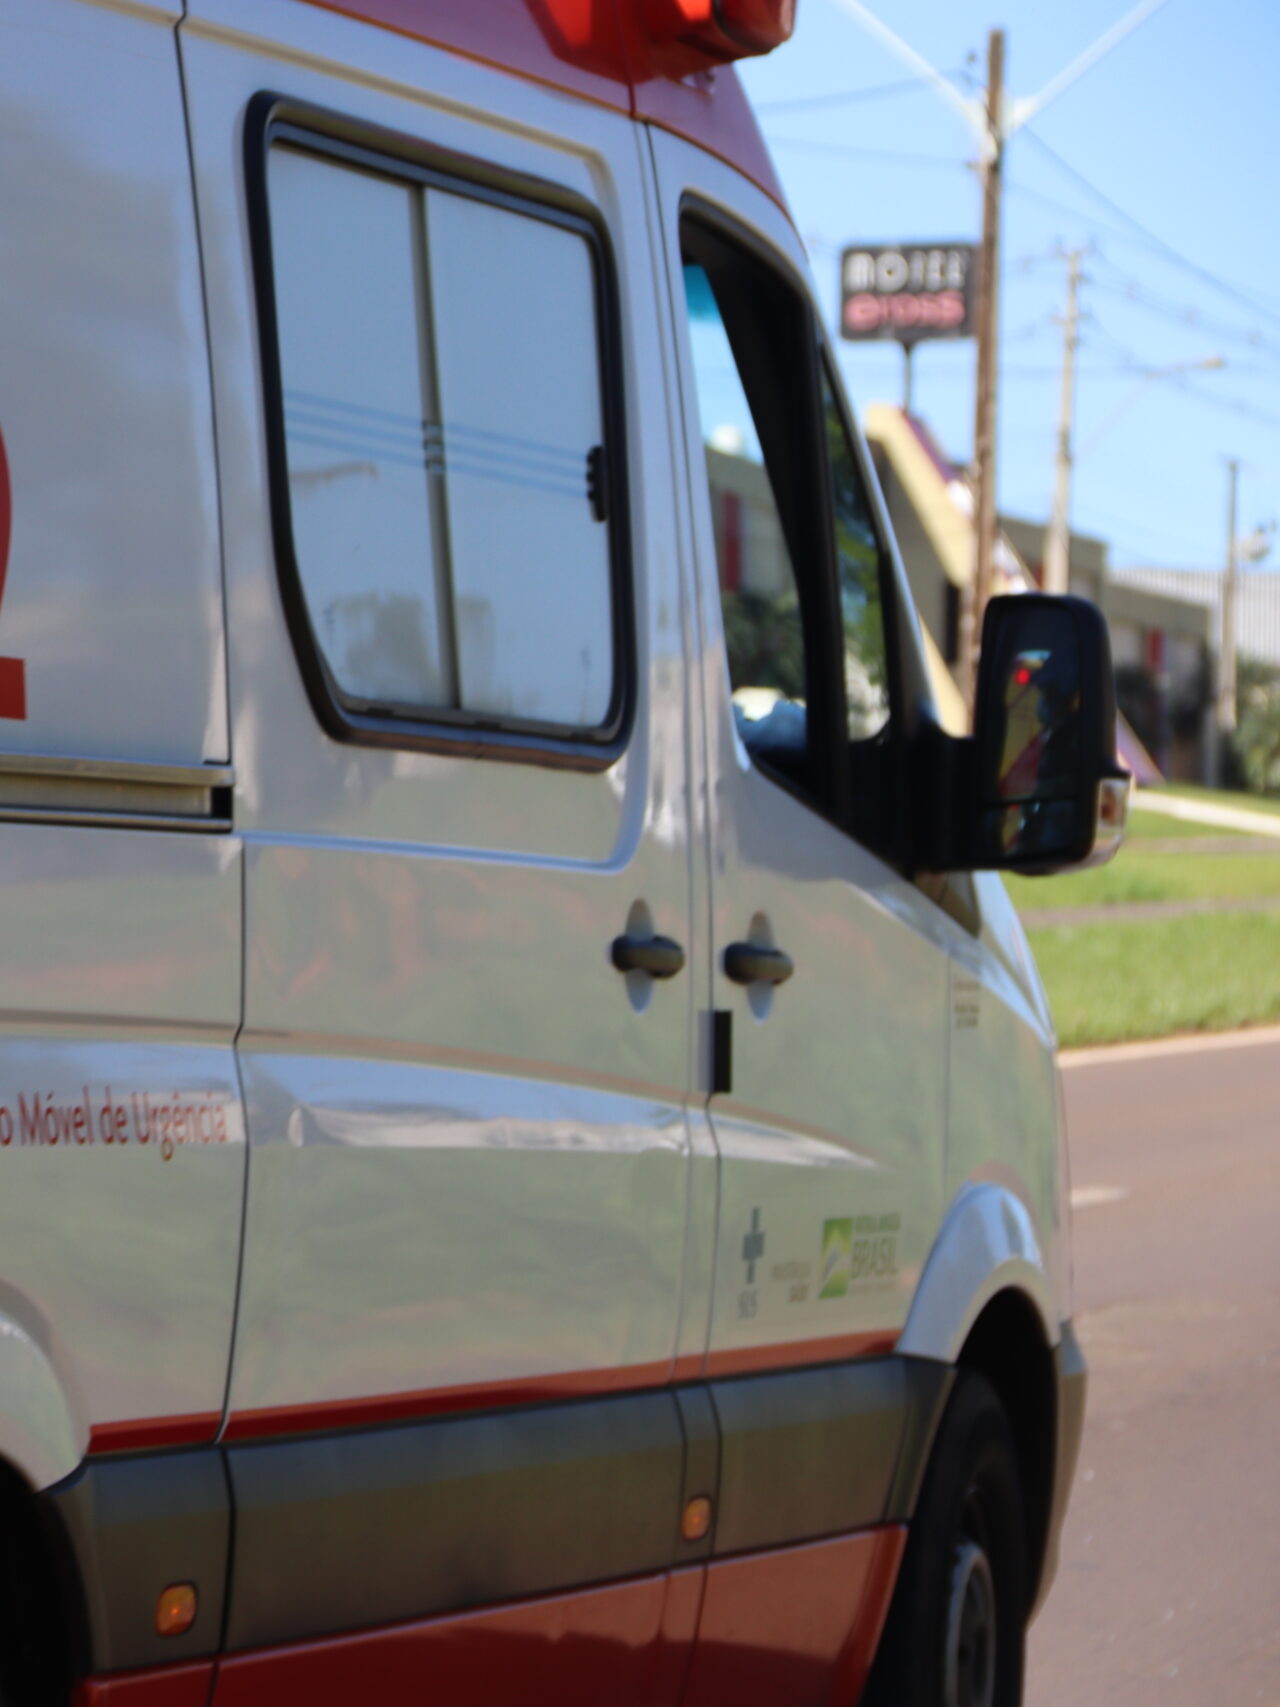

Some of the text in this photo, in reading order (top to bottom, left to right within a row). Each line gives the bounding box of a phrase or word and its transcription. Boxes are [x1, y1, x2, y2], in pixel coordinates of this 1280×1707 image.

[19, 1086, 94, 1148] Móvel
[99, 1087, 128, 1145] de
[134, 1088, 228, 1162] Urgência
